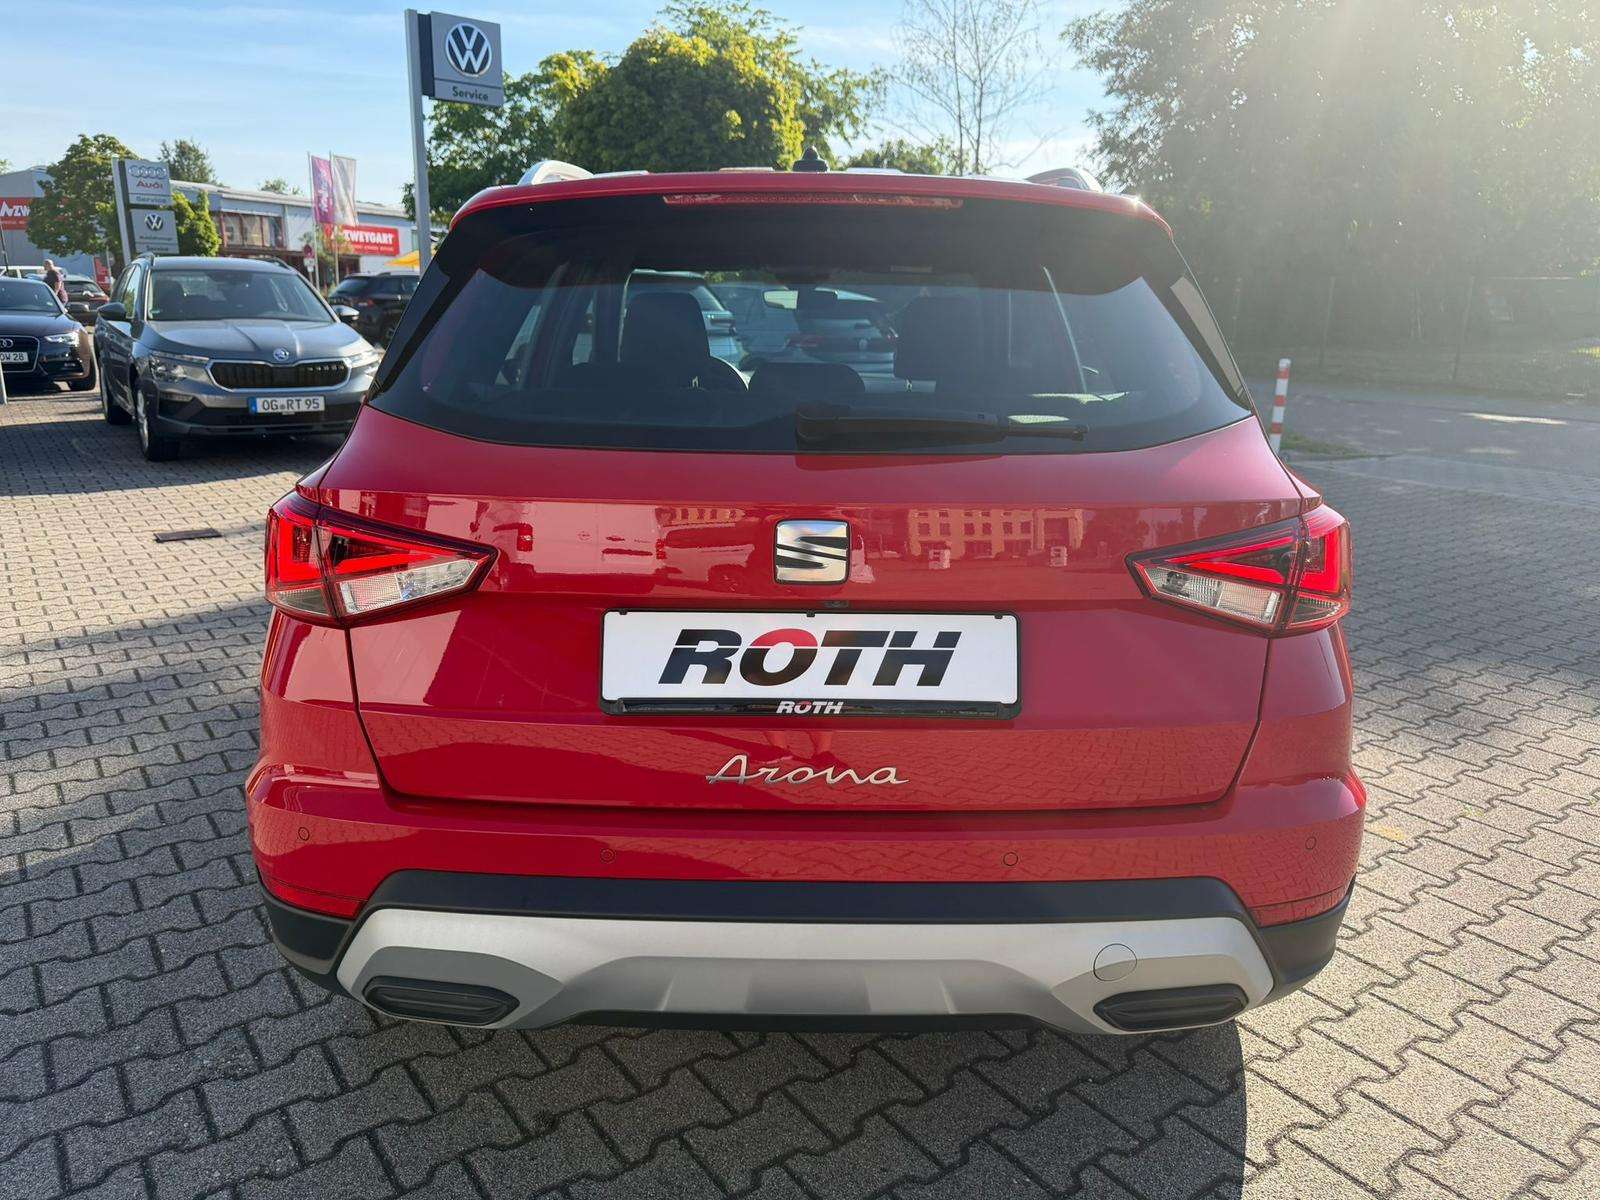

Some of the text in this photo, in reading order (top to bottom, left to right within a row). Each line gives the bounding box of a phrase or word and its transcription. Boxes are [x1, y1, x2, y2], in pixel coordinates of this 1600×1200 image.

[452, 86, 488, 101] Service
[136, 180, 163, 189] Audi
[262, 398, 320, 411] OG RT 95
[658, 628, 962, 686] ROTH
[776, 701, 844, 714] ROTH
[705, 754, 909, 784] Arona
